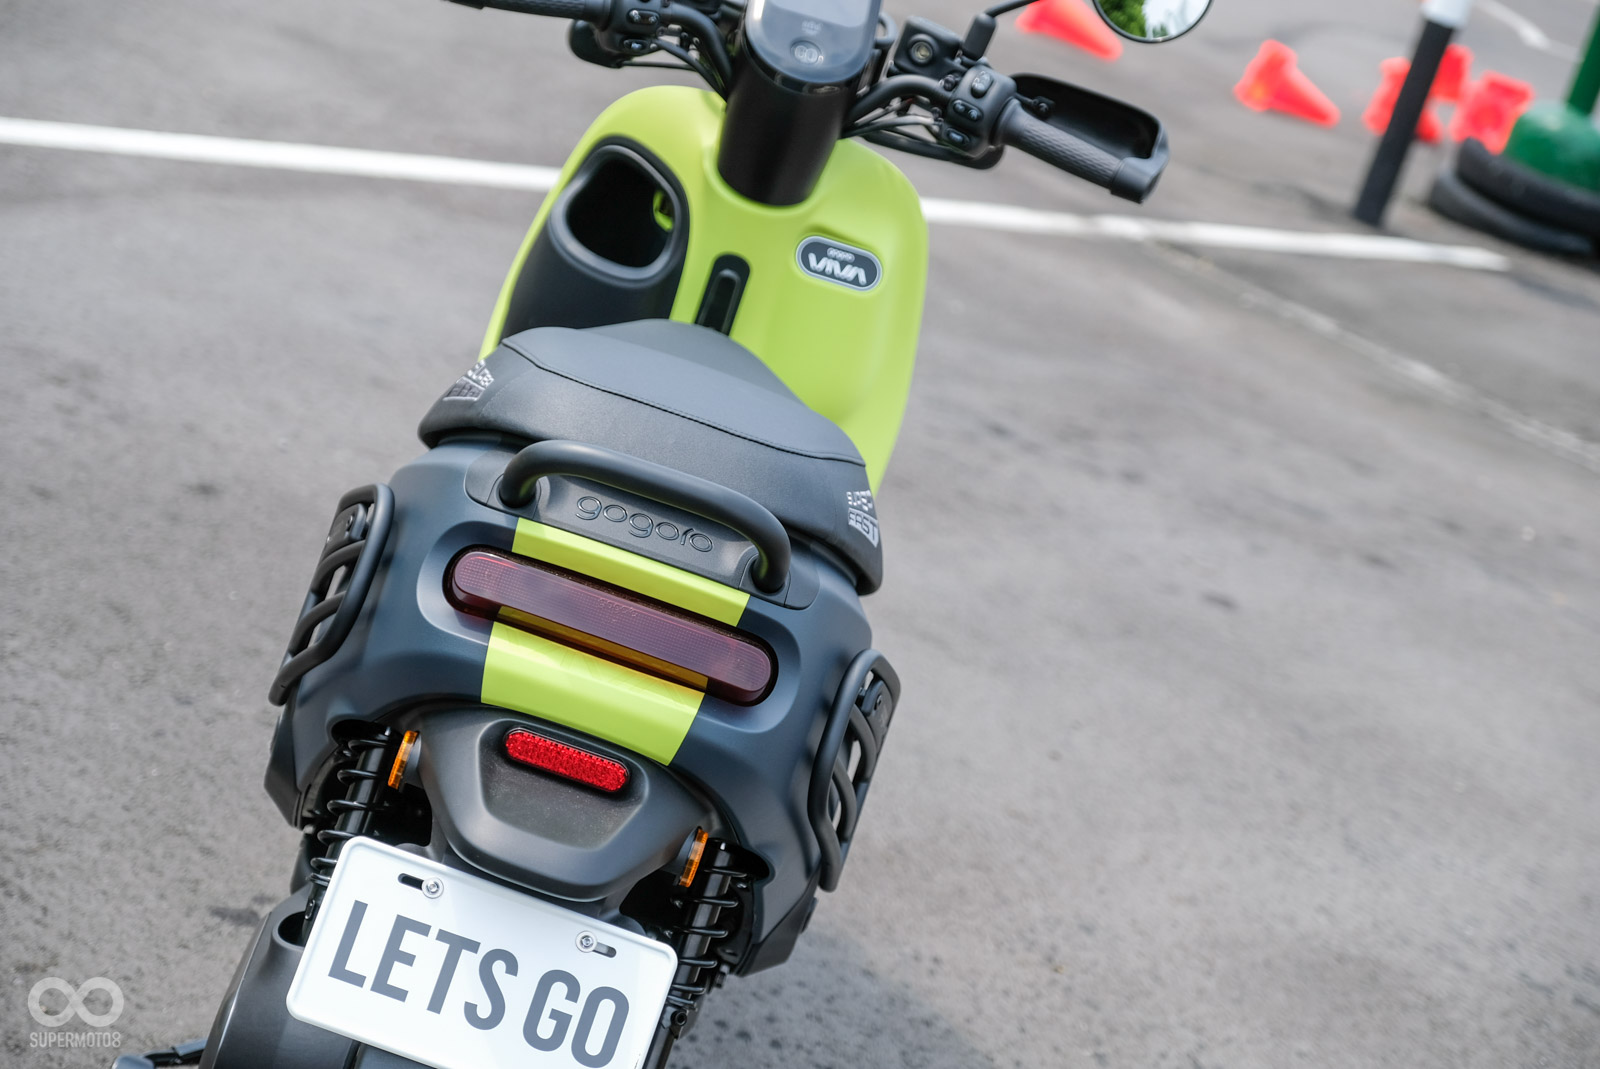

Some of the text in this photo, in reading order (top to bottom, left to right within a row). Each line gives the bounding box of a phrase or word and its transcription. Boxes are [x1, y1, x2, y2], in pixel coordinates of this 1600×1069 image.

[808, 252, 867, 285] VIVA
[575, 496, 713, 552] gogoro
[328, 900, 629, 1068] LETS GO
